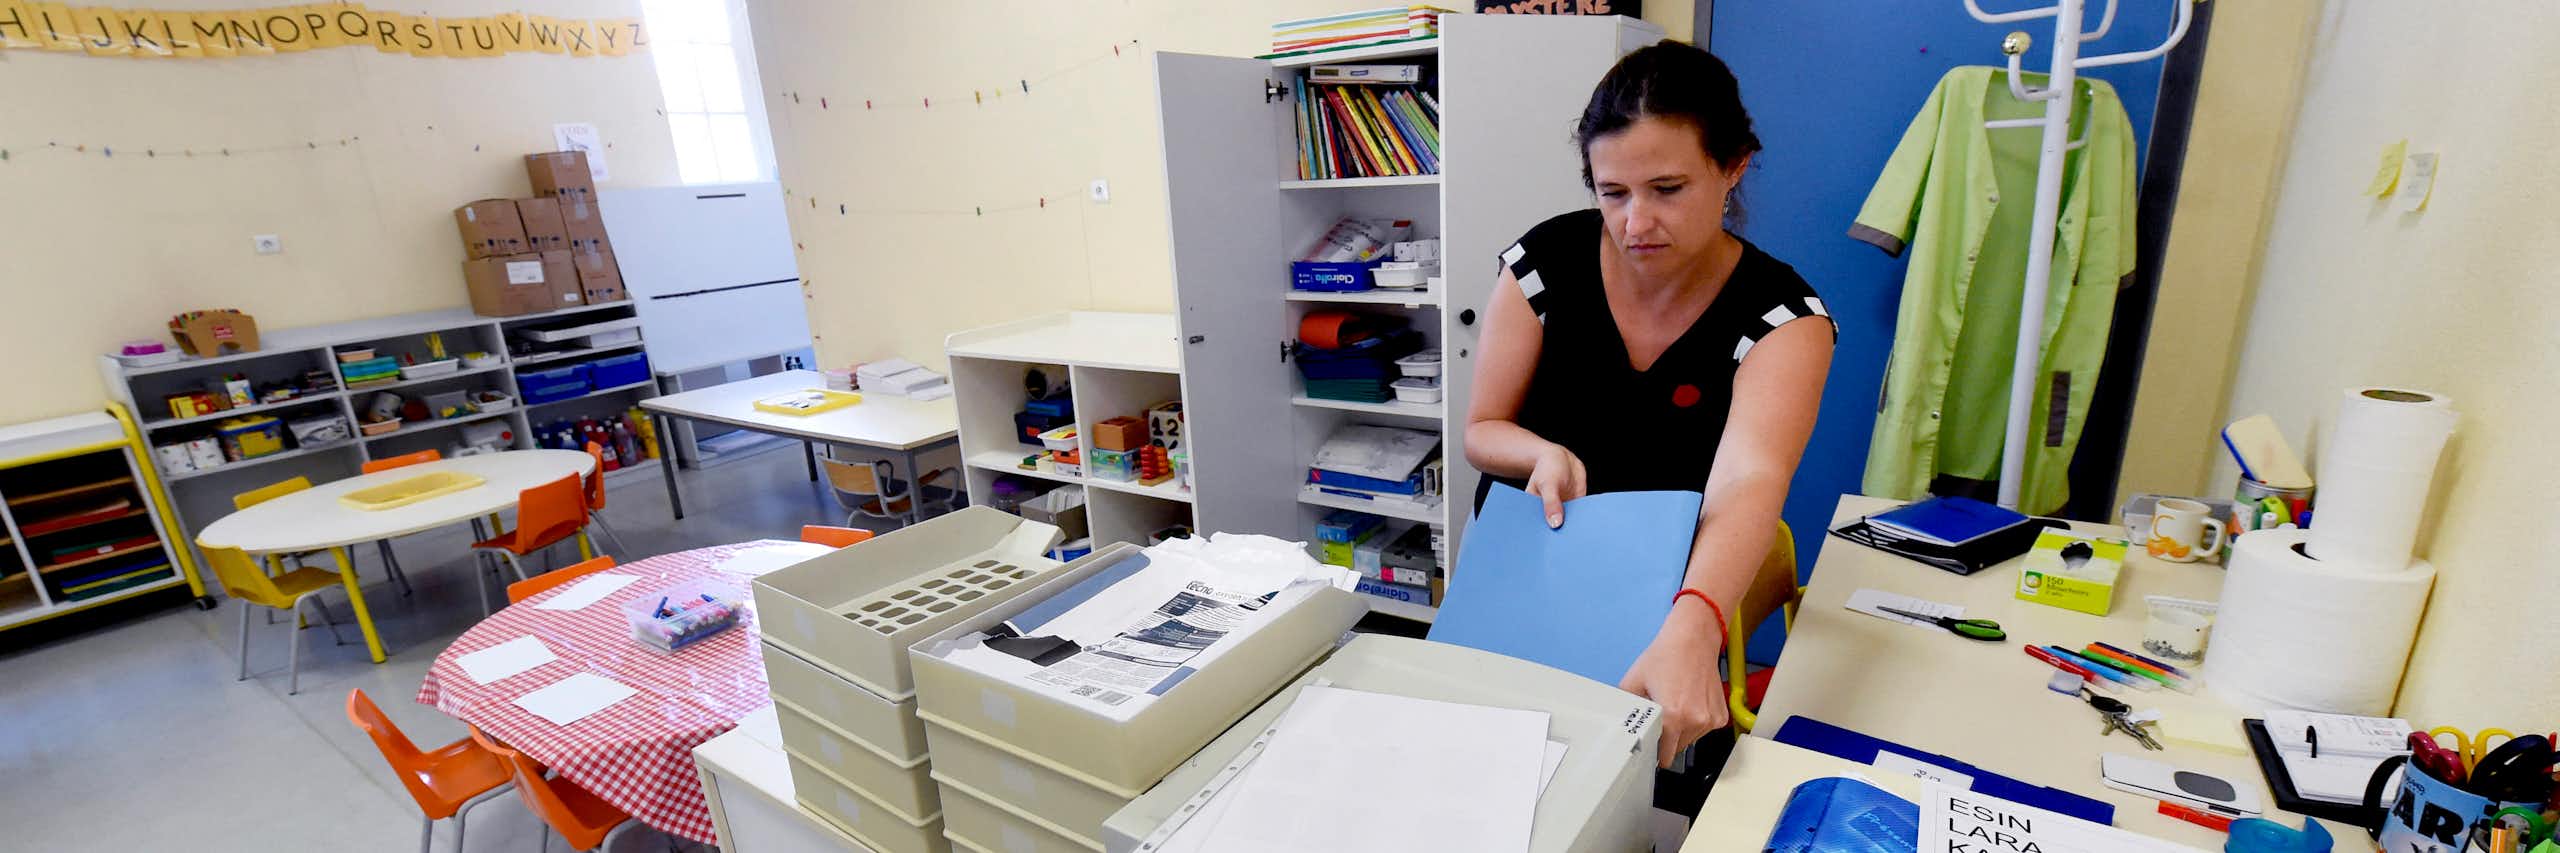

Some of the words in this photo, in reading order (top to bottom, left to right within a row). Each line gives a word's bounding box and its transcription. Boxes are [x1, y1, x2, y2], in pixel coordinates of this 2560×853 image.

[1186, 581, 1214, 595] tecno
[1950, 797, 2031, 834] ESIN
[1949, 817, 2042, 853] LARA
